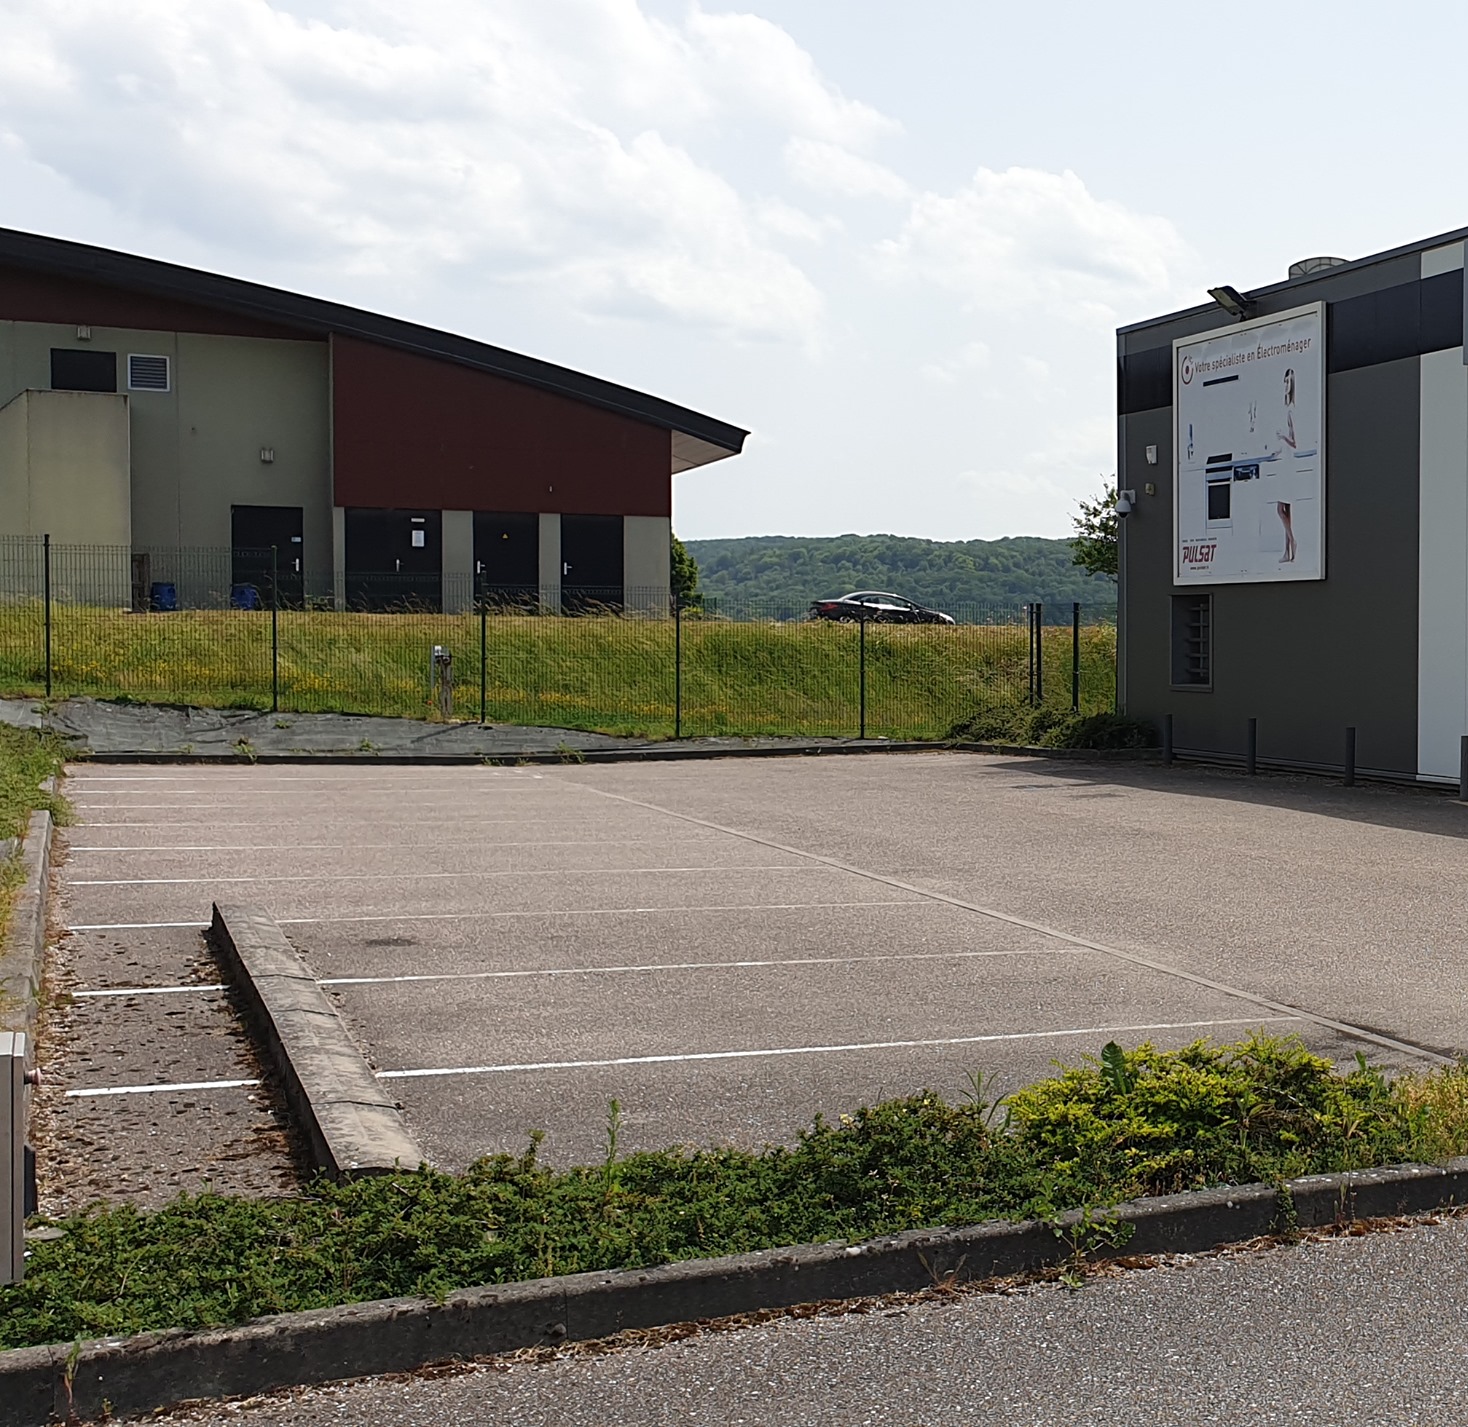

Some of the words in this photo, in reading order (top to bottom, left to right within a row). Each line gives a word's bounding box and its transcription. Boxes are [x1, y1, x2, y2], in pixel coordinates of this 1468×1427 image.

[1194, 362, 1211, 374] Votre
[1211, 353, 1246, 373] spécialiste
[1246, 351, 1256, 362] en
